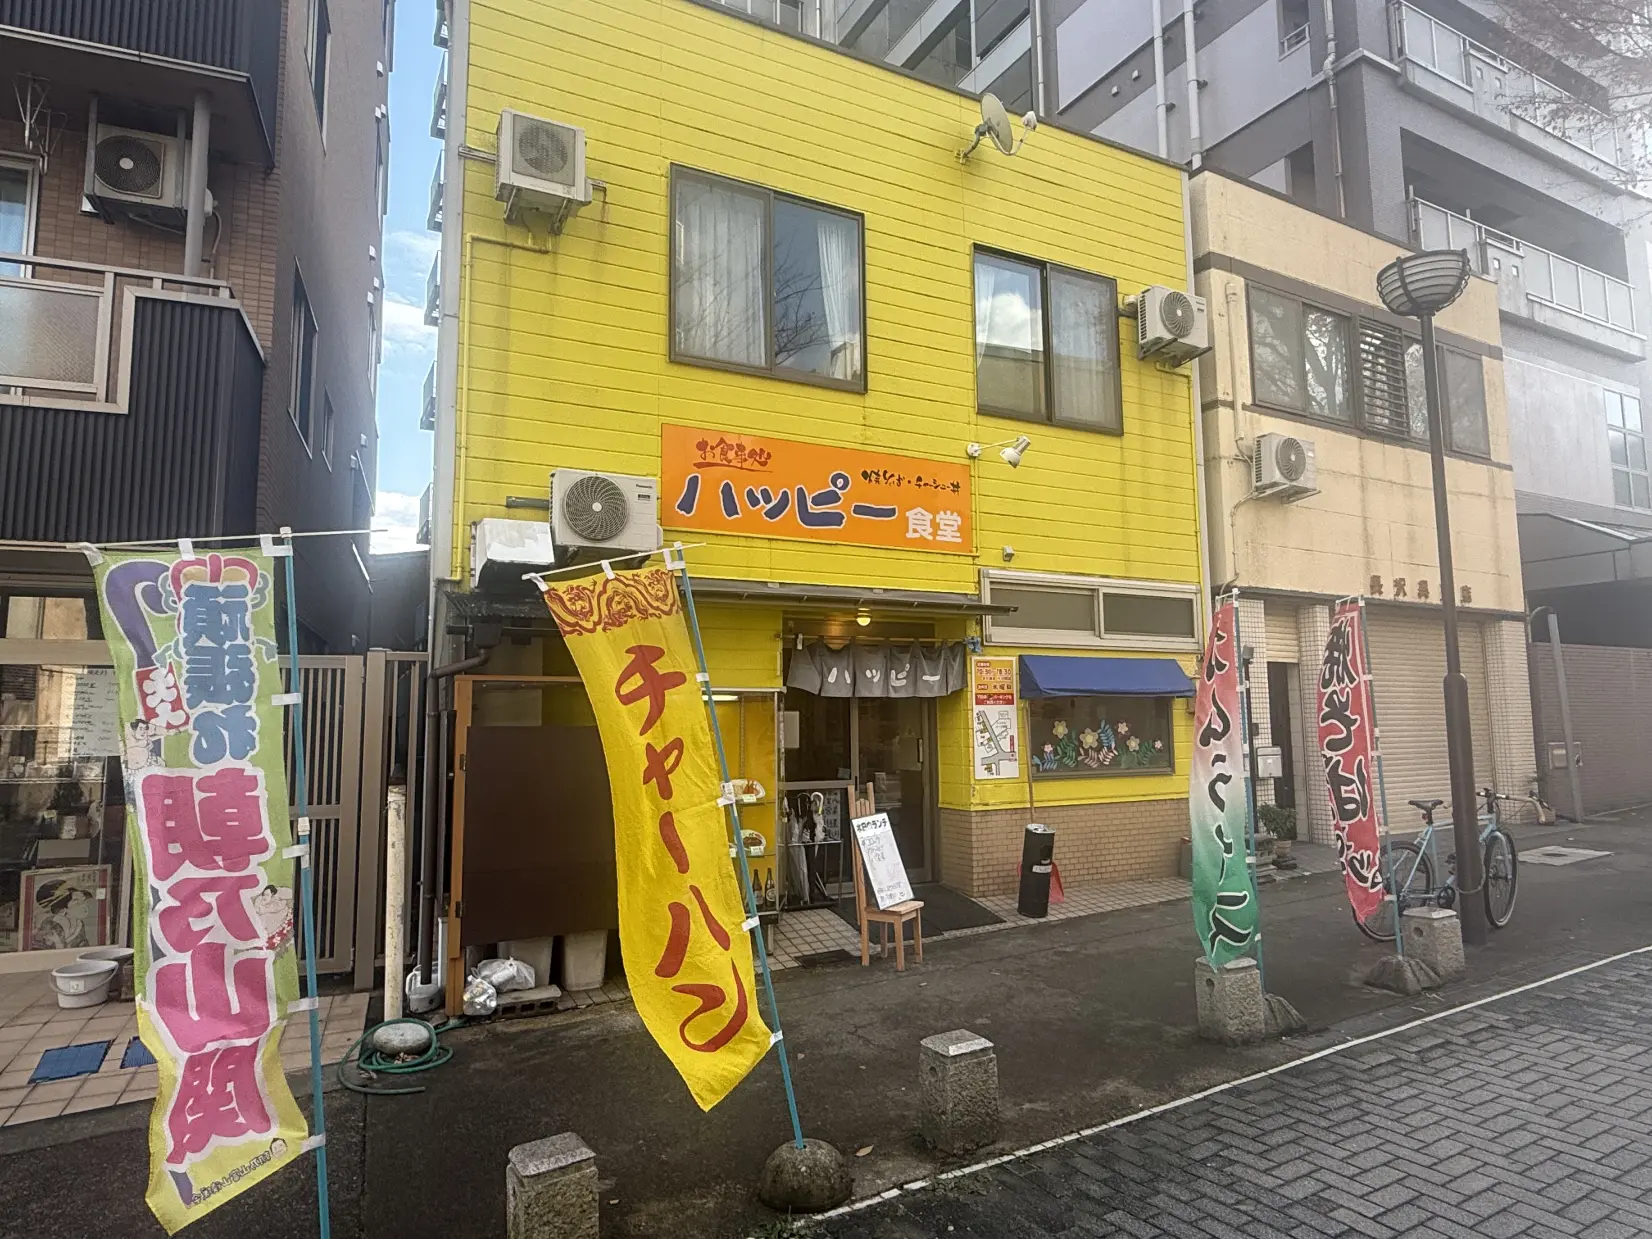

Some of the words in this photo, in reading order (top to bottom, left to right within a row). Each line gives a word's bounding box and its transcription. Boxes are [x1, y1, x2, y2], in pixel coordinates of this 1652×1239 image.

[676, 471, 898, 529] ハッピー
[905, 507, 962, 543] 食堂
[827, 663, 941, 687] ハッピー
[615, 644, 749, 1053] チャーハン
